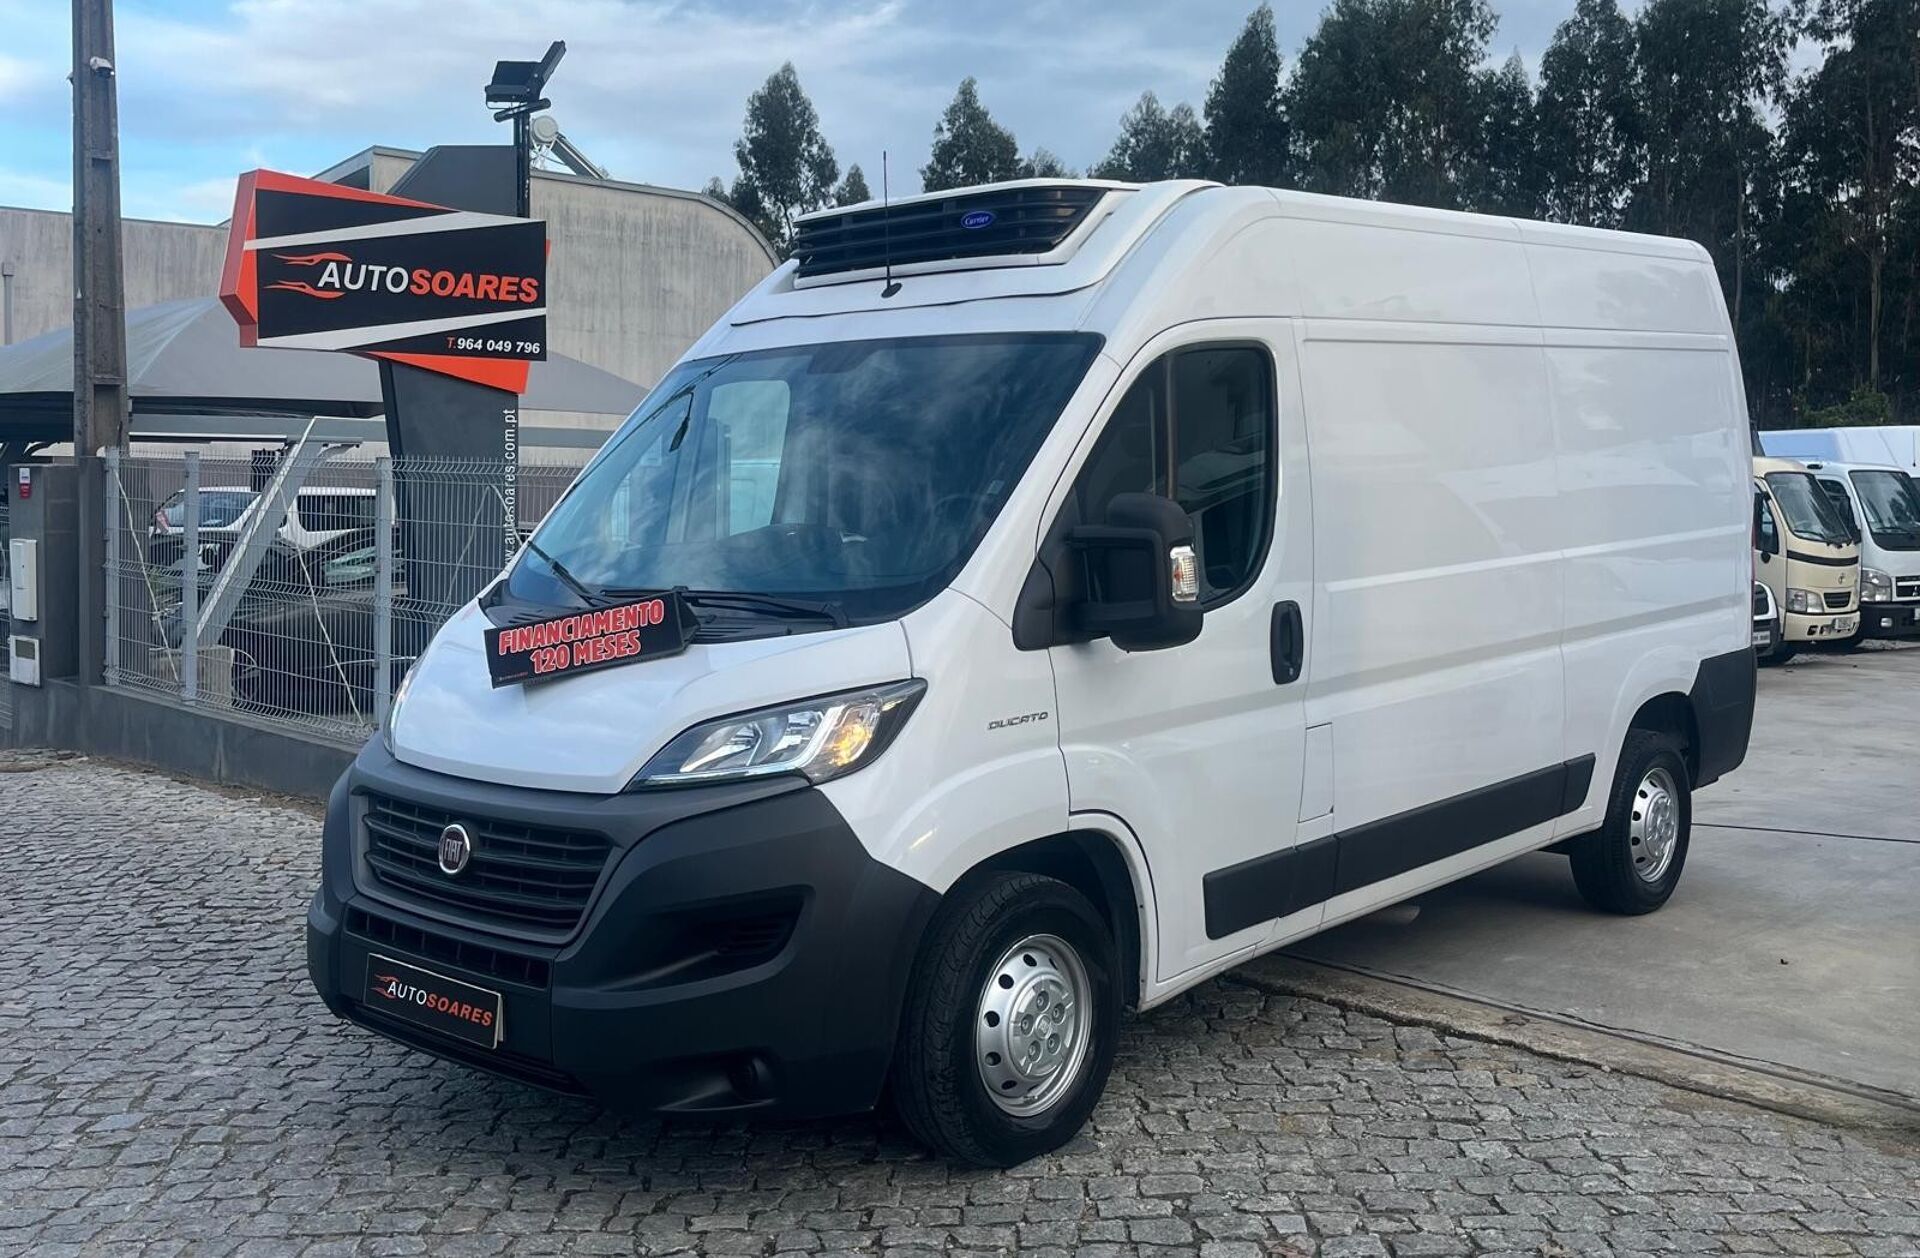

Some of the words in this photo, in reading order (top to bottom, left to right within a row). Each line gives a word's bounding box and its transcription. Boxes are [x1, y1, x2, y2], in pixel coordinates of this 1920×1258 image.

[317, 262, 540, 303] AUTOSOARES
[486, 340, 512, 352] 049
[516, 341, 541, 354] 796
[498, 599, 665, 655] FINANCIAMENTO
[530, 643, 571, 674] 120
[573, 630, 642, 666] MESES
[988, 711, 1049, 730] DUCATO
[443, 838, 463, 863] FIAT
[387, 981, 493, 1027] AUTOSOARES
